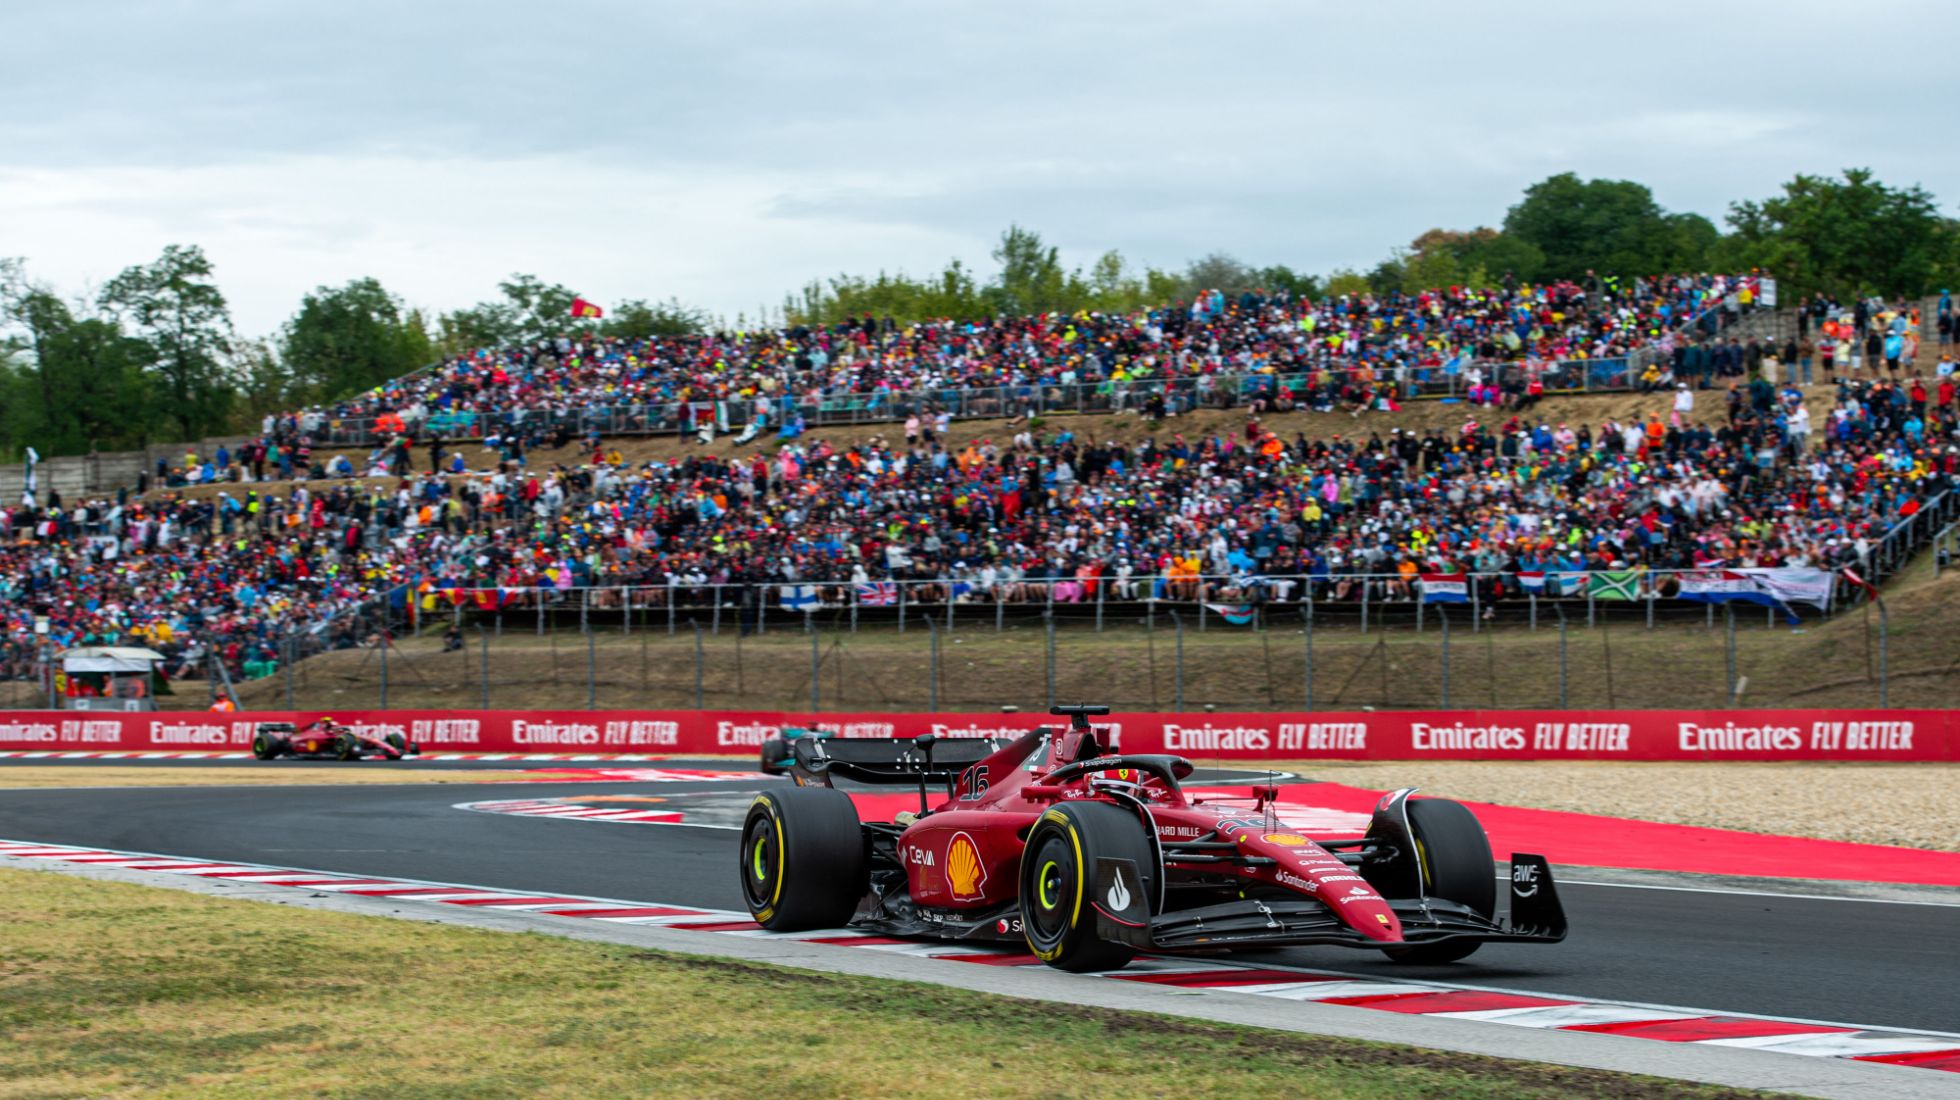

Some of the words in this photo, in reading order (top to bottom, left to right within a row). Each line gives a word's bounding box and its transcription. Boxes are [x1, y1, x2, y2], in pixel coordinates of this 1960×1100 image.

[0, 720, 57, 742] mirates
[61, 720, 81, 742] FLY
[82, 720, 122, 742] BETTER
[150, 721, 227, 743] Emirates
[231, 722, 252, 743] FLY
[411, 720, 433, 743] FLY
[434, 720, 480, 743] BETTER
[512, 720, 599, 744] Emirates
[604, 721, 629, 744] FLY
[630, 721, 679, 744] BETTER
[717, 721, 788, 746] Emira
[1163, 723, 1270, 750] Emirates
[1277, 724, 1307, 750] FLY
[1308, 724, 1367, 750] BETTER
[1411, 722, 1526, 750] Emirates
[1534, 723, 1565, 750] FLY
[1566, 723, 1631, 750] BETTER
[1678, 722, 1802, 750] Emirates
[1811, 722, 1844, 750] FLY
[1845, 722, 1914, 750] BETTER
[1084, 758, 1122, 767] Snapdragon
[959, 765, 990, 802] 16
[1156, 825, 1176, 836] HARD
[1177, 826, 1200, 837] MILLE
[1283, 871, 1320, 892] Santander
